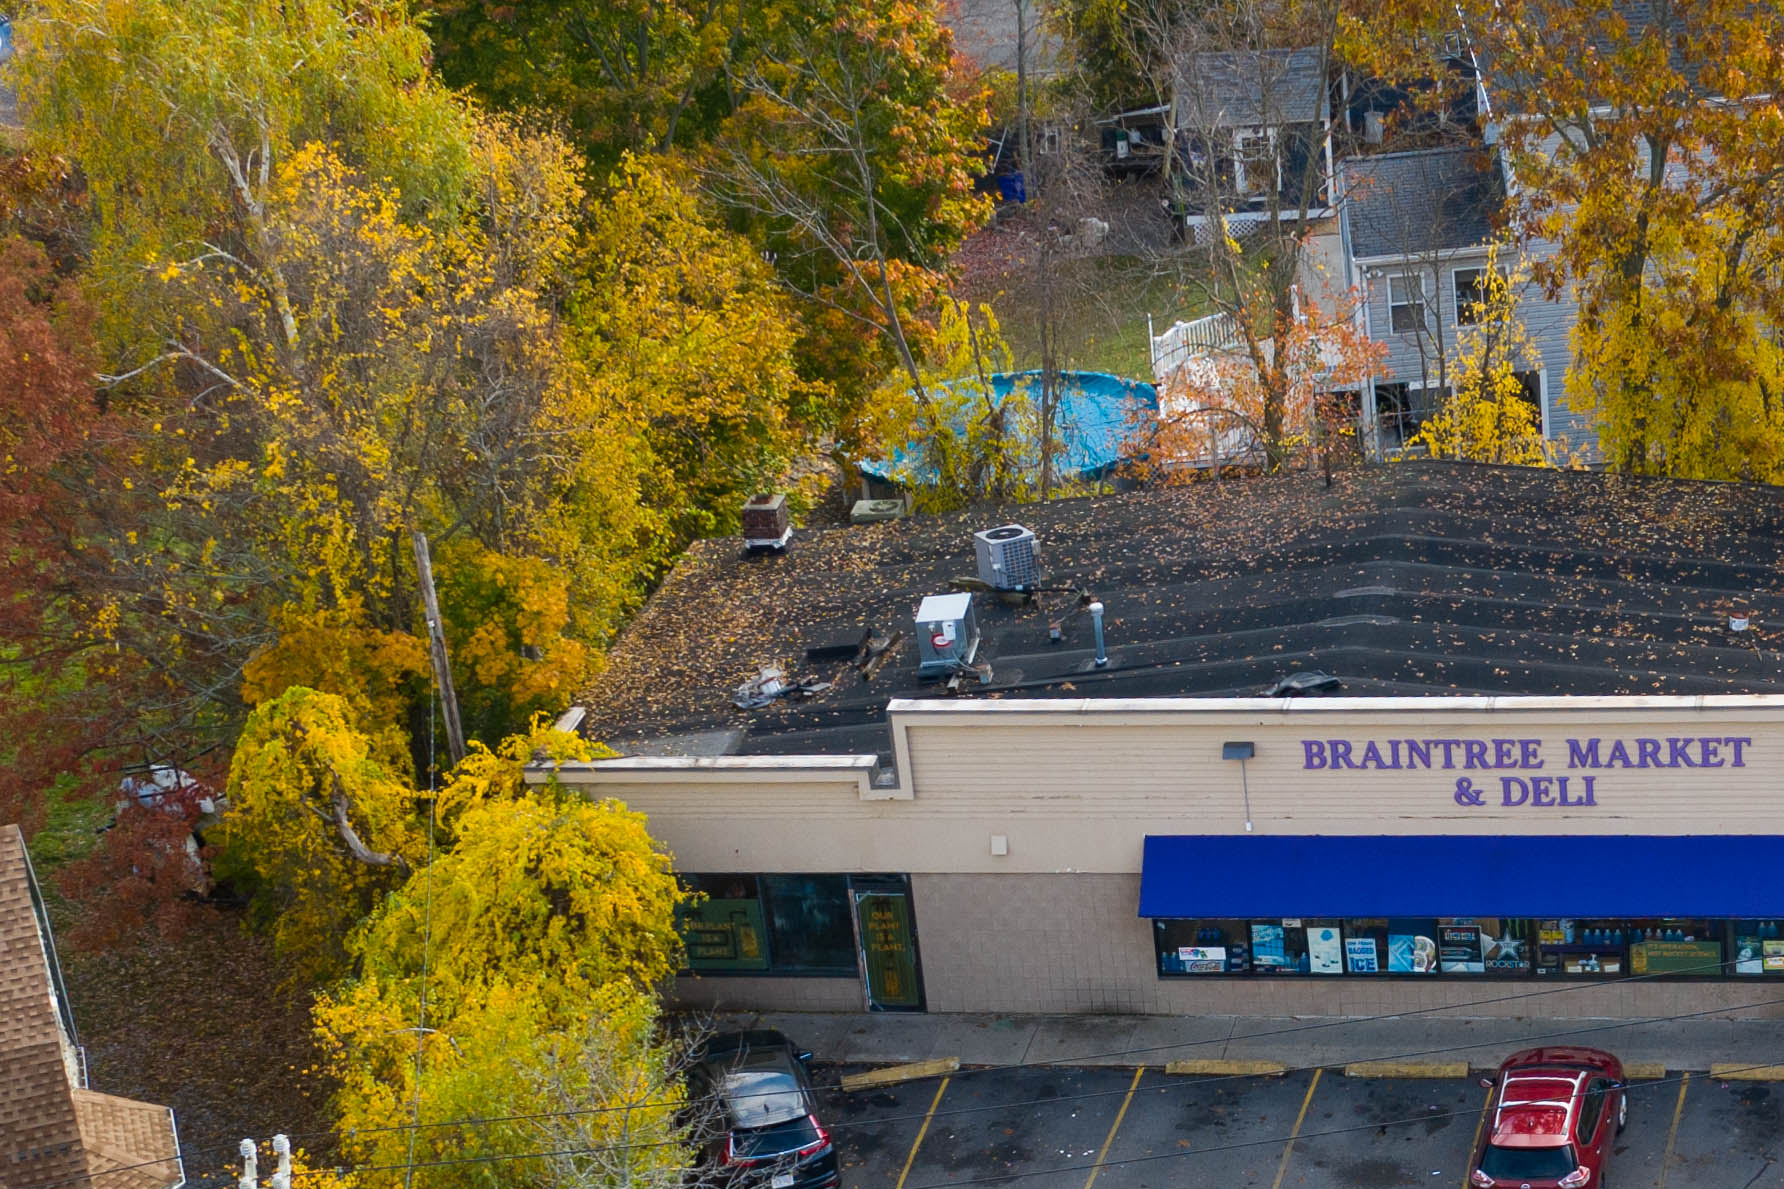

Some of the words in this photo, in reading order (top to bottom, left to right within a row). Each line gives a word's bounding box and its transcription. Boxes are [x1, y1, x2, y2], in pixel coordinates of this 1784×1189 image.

[1302, 738, 1545, 770] BRAINTREE
[1567, 737, 1752, 769] MARKET
[1454, 776, 1486, 806] &
[1500, 775, 1598, 807] DELI
[871, 911, 894, 921] OUR
[1349, 957, 1376, 971] ICE
